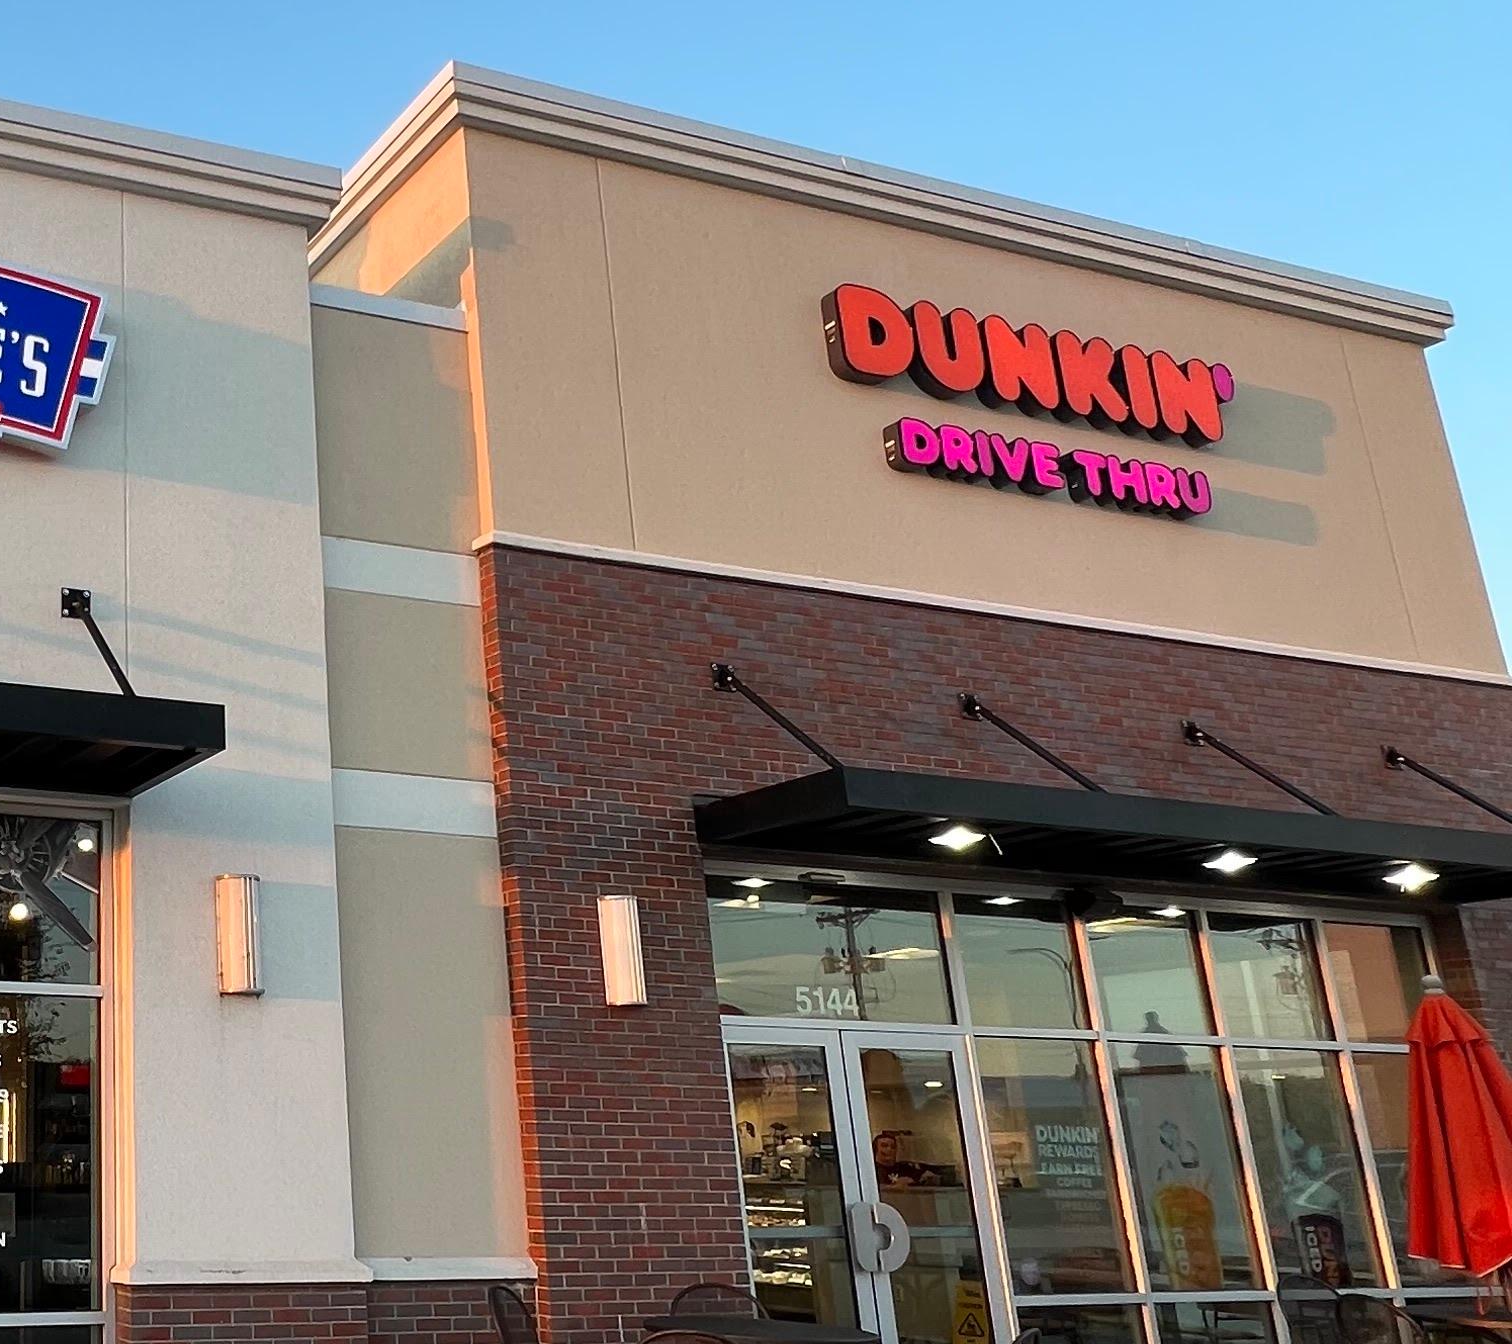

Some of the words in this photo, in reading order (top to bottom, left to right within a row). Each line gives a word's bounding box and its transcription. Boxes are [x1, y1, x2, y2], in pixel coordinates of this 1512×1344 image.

[824, 283, 1235, 446] DUNKIN'
[888, 417, 1066, 493] DRIVE
[1069, 449, 1213, 516] THRU
[795, 985, 860, 1017] 5144
